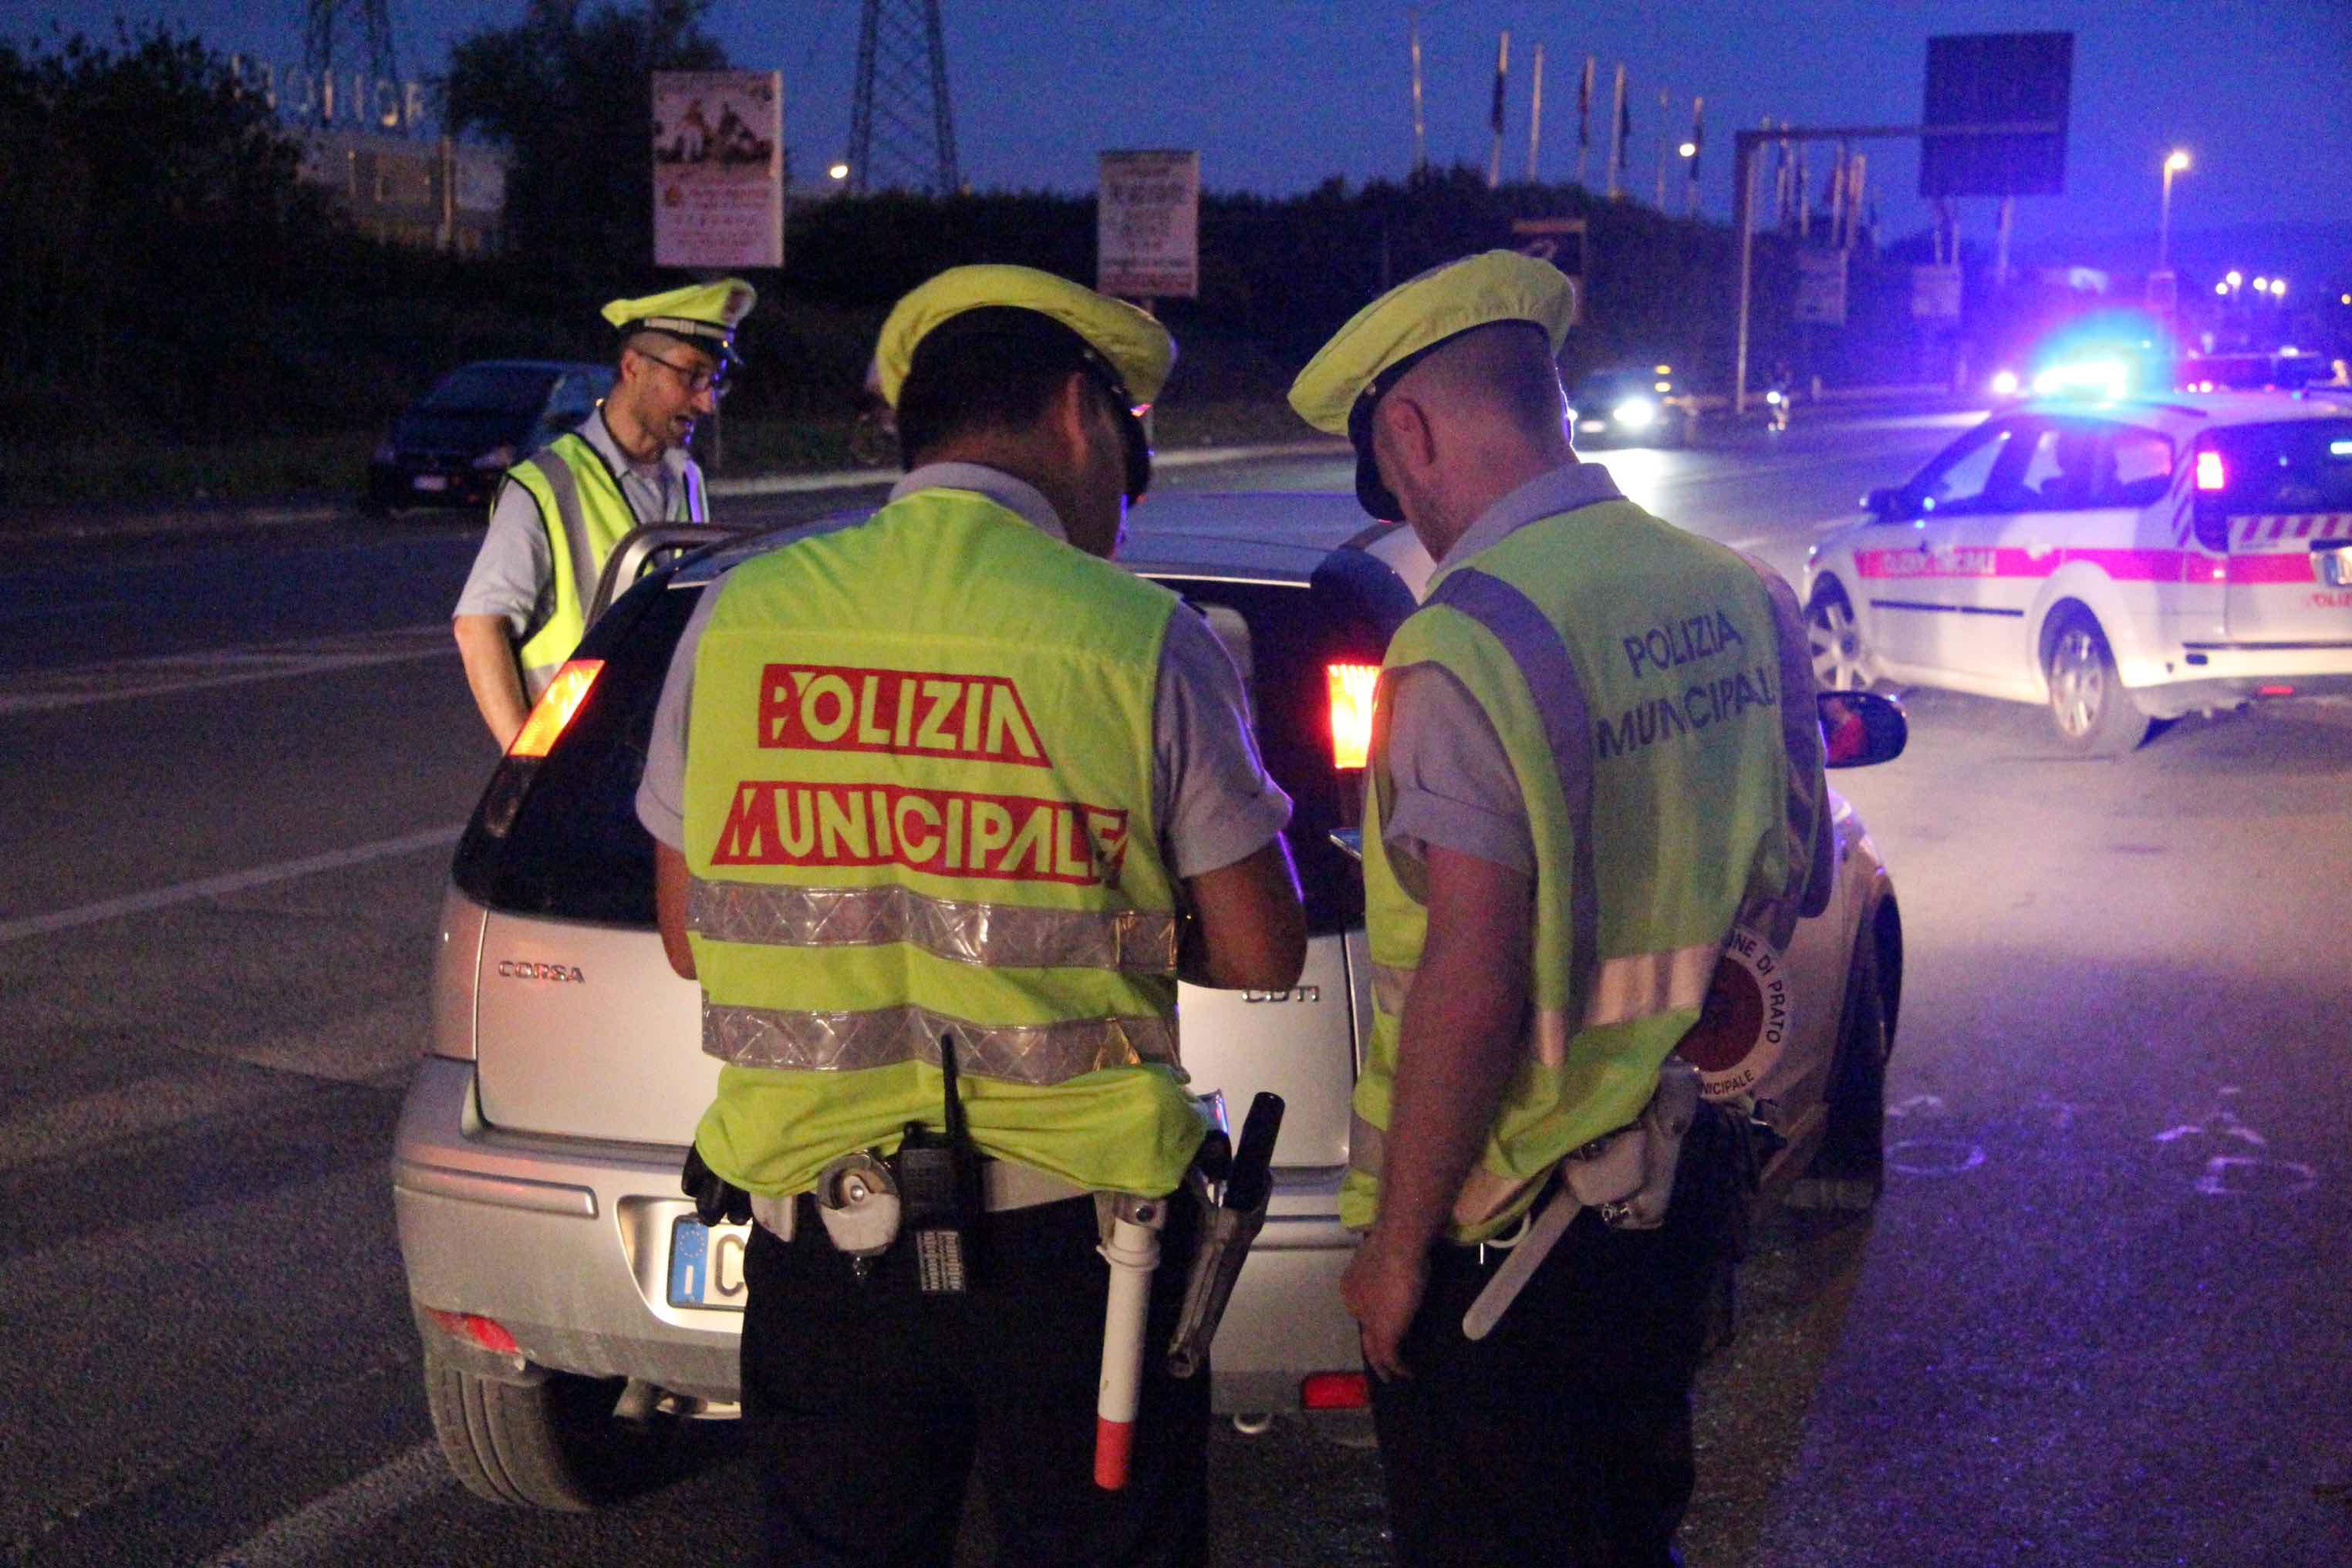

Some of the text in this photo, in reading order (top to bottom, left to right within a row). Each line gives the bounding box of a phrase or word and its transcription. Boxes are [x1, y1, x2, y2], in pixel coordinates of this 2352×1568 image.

[1623, 609, 1743, 679] POLIZIA
[773, 672, 1041, 759] POLIZIA
[728, 787, 1129, 878] MUNICIPALE
[498, 960, 585, 983] CORSA
[1756, 955, 1774, 976] DI
[1766, 980, 1786, 1044] PRATO
[1702, 1069, 1754, 1095] NICIPALE
[714, 1233, 746, 1297] C
